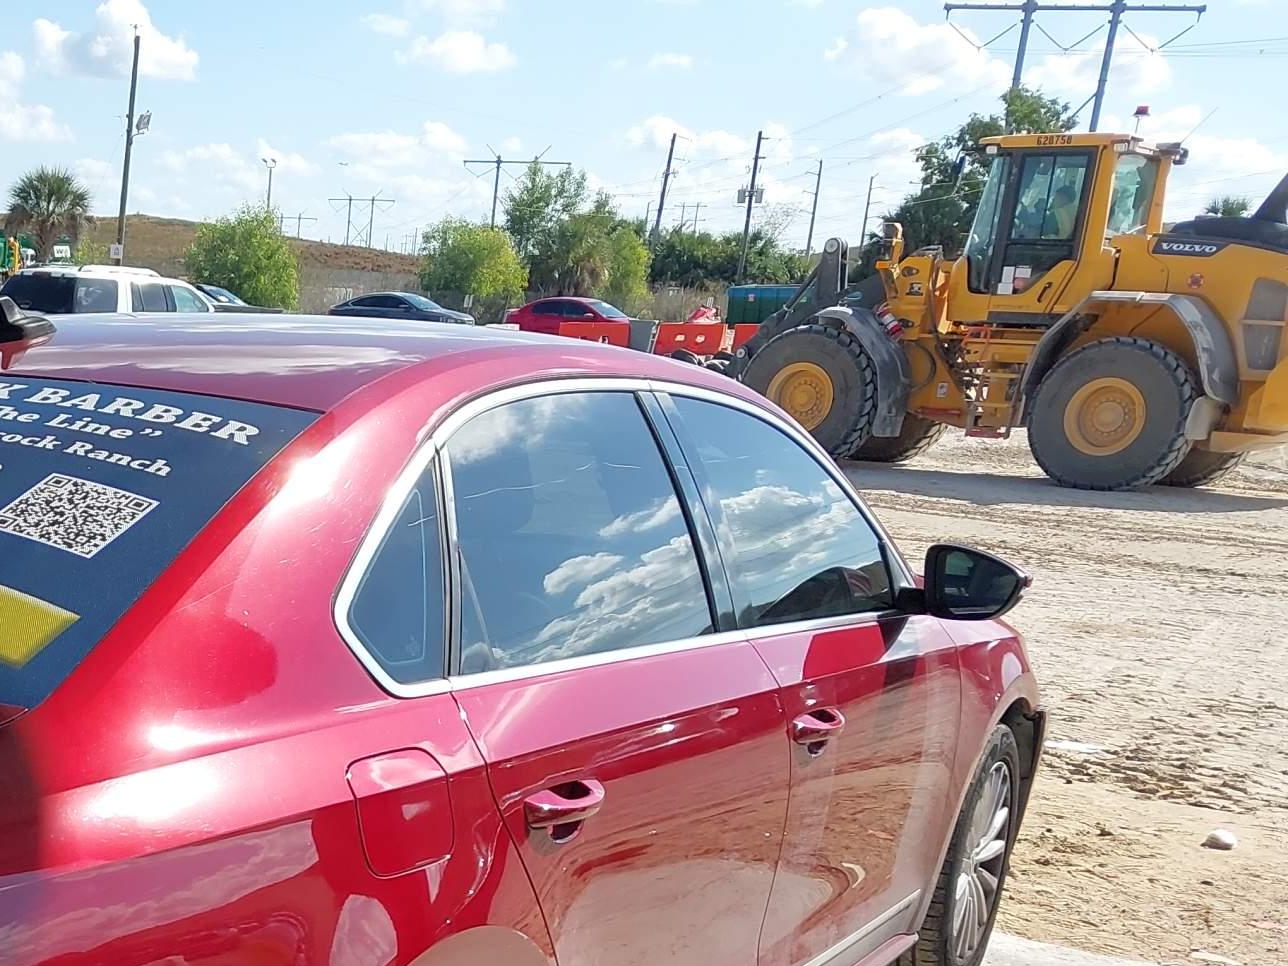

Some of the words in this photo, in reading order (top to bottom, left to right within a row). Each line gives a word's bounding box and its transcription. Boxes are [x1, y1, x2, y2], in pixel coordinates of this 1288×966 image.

[1161, 242, 1217, 254] VOLVO
[24, 387, 260, 445] BARBER
[63, 441, 172, 477] Ranch
